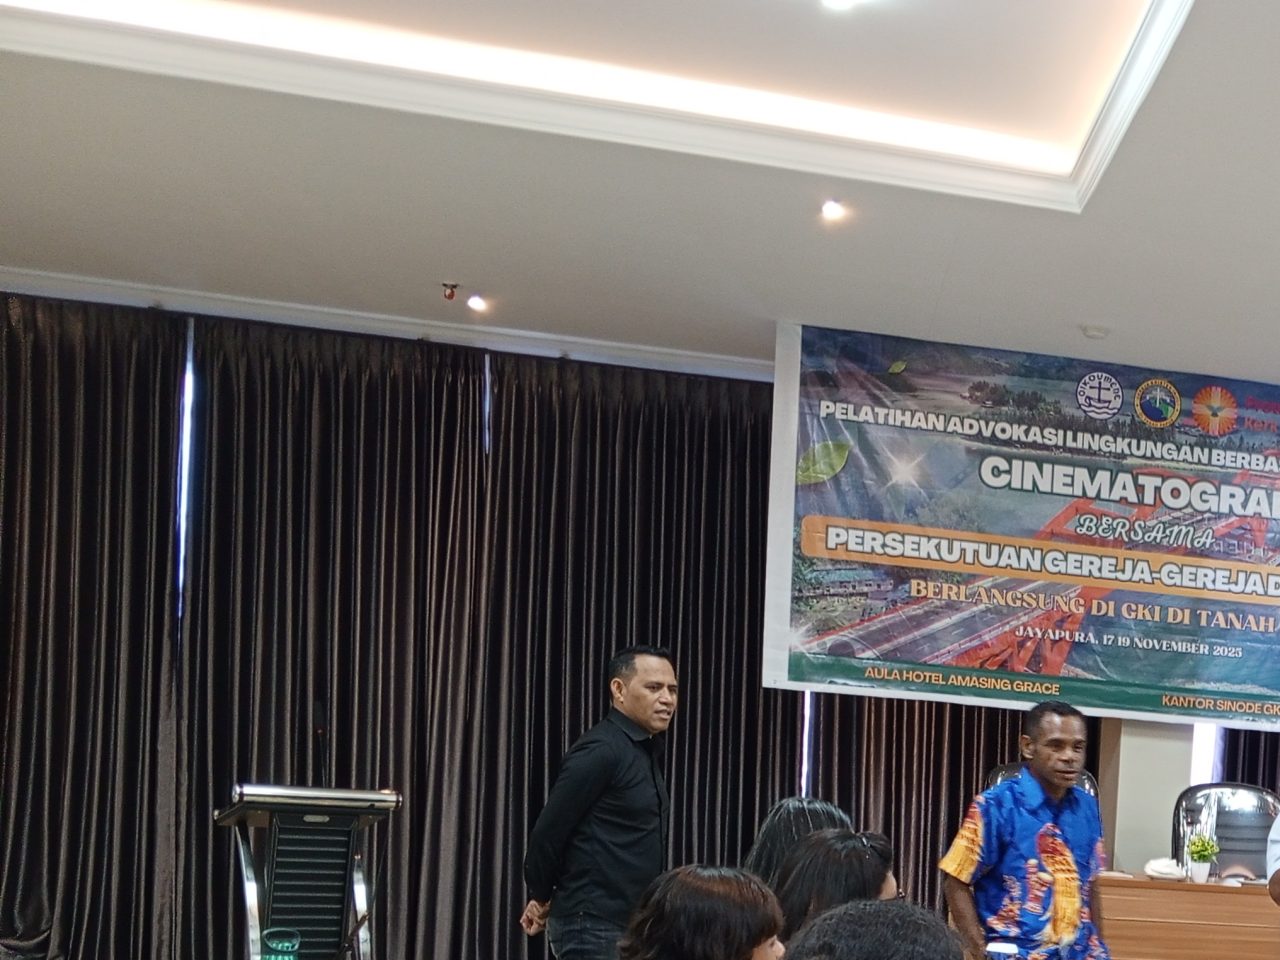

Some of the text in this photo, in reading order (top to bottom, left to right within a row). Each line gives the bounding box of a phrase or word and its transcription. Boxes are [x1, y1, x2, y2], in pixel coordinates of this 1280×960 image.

[819, 400, 946, 432] PELATIHAN
[946, 416, 1064, 447] ADVOKASI
[1066, 432, 1209, 465] LINGKUNGAN
[1244, 417, 1278, 433] Kerk
[1076, 514, 1216, 549] BERSAMA
[826, 526, 1043, 572] PERSEKUTUAN
[1044, 549, 1266, 596] GEREJA-GEREJA
[910, 579, 1085, 615] BERLANGSUNG
[1091, 599, 1115, 618] DI
[1121, 604, 1162, 622] GKI
[1167, 607, 1191, 625] DI
[1197, 610, 1276, 633] TANAH
[1103, 634, 1115, 646] 17
[1117, 636, 1131, 648] 19
[1132, 638, 1209, 655] NOVEMBER
[1212, 645, 1243, 658] 2025
[865, 666, 1061, 696] AULA HOTEL AMASING GRACE
[1162, 694, 1215, 709] KANTOR
[1216, 699, 1262, 714] SINODE
